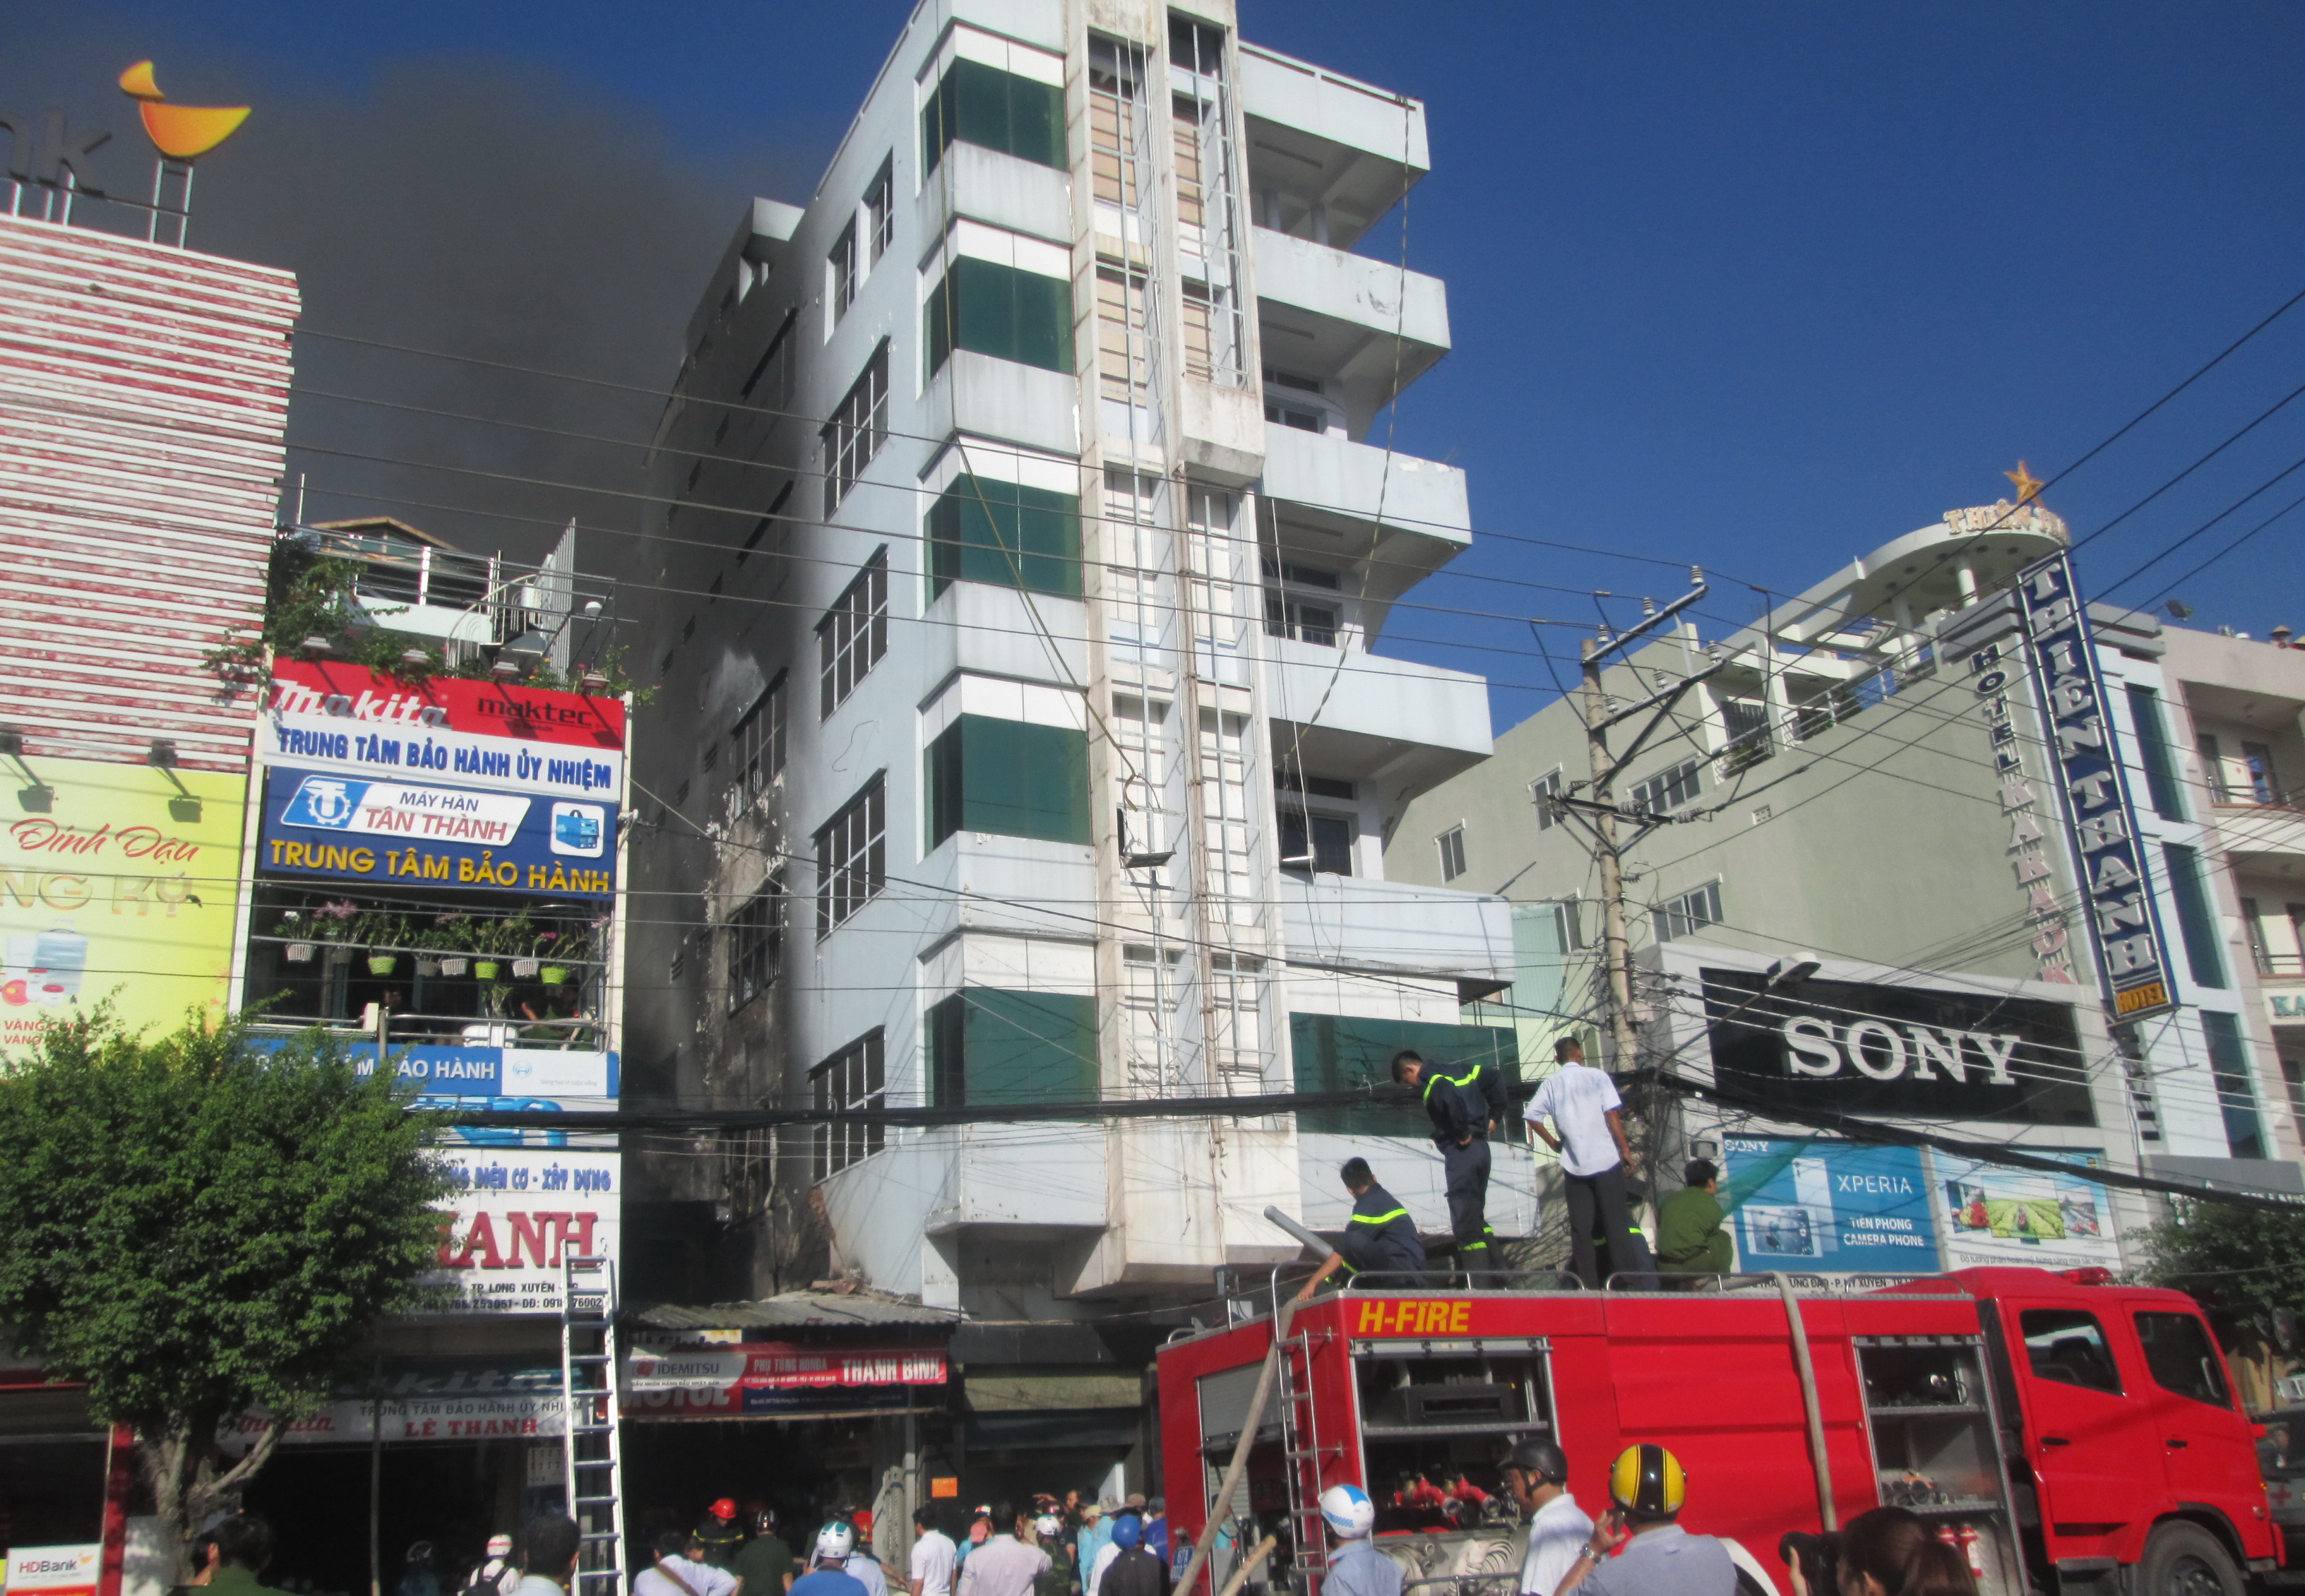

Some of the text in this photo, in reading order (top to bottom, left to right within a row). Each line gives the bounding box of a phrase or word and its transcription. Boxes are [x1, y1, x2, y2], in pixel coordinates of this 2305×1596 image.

[479, 697, 592, 726] maktec
[1970, 642, 2022, 772] HOTEL
[280, 727, 611, 790] TRUNG TÂM BẢO HÀNH ỦY NHIỆM
[400, 792, 478, 811] MÁY HÀN
[366, 806, 508, 841] TÂN THÀNH
[270, 839, 609, 893] TRUNG TÂM BẢO HÀNH
[2117, 982, 2167, 1014] HOTEL
[1784, 1016, 2021, 1085] SONY
[436, 1057, 494, 1079] HÀNH
[1724, 1140, 1768, 1153] SONY
[542, 1162, 568, 1191] XÂY
[573, 1168, 611, 1198] DỰNG
[1837, 1174, 1914, 1194] XPERIA
[1875, 1218, 1912, 1230] PHONG
[1844, 1234, 1924, 1246] CAMERA PHONE
[489, 1283, 516, 1293] LONG
[520, 1280, 555, 1293] XUYÊN
[1358, 1301, 1472, 1333] H-FIRE
[657, 1363, 719, 1374] IDEMITSU
[799, 1357, 827, 1371] HONDA
[842, 1352, 940, 1382] THANH BÌNH
[405, 1417, 437, 1437] LÊ
[20, 1559, 77, 1573] HDBank
